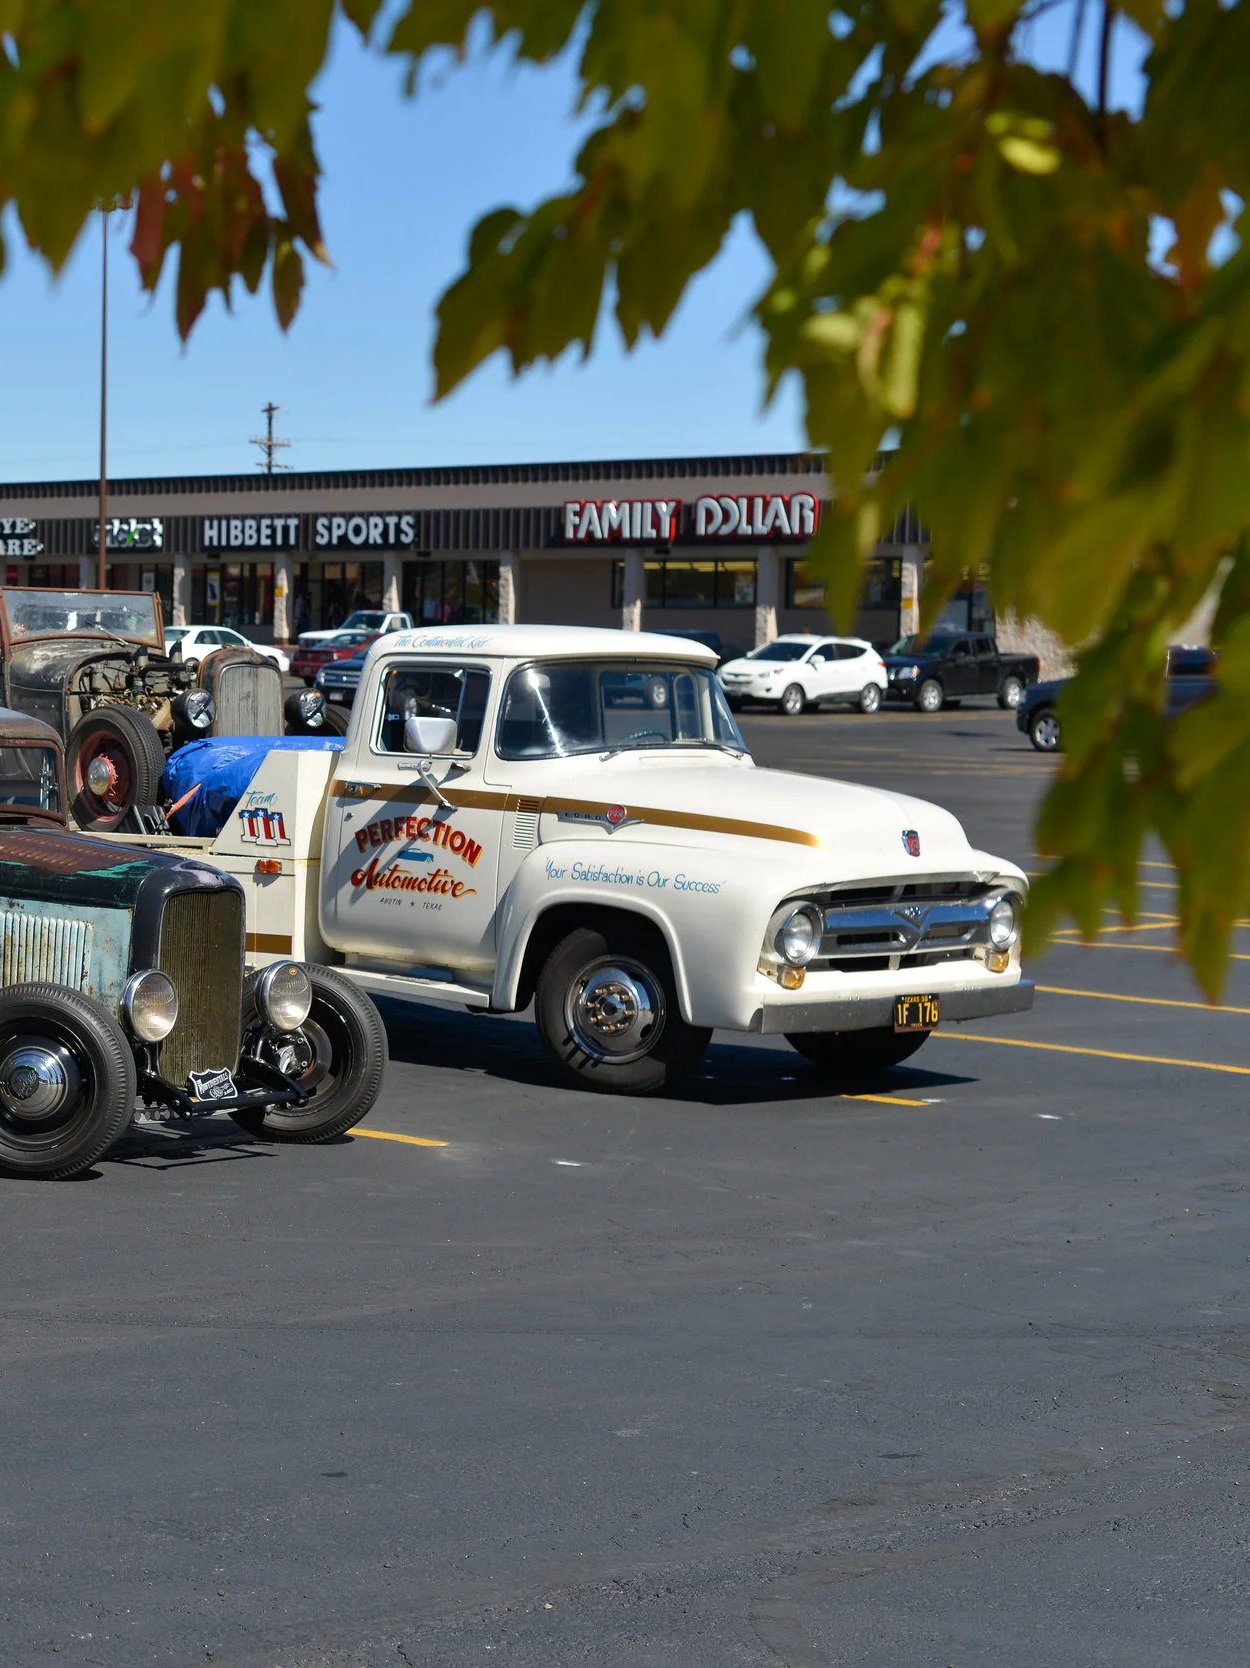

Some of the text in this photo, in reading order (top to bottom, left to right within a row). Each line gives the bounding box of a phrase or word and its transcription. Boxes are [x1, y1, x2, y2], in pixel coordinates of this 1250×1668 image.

[204, 515, 415, 546] HIBBETT SPORTS
[565, 494, 817, 541] FAMILY DOLLAR
[394, 634, 411, 648] The
[246, 790, 279, 809] Team
[239, 807, 291, 847] 111
[565, 811, 602, 820] FORD
[355, 816, 485, 869] PERFECTION
[350, 857, 478, 899] Automotive
[571, 861, 633, 884] Satisfaction
[636, 869, 645, 886] is
[647, 870, 670, 888] Our
[380, 897, 443, 911] AUSTIN TEXAS
[918, 1001, 939, 1023] 176
